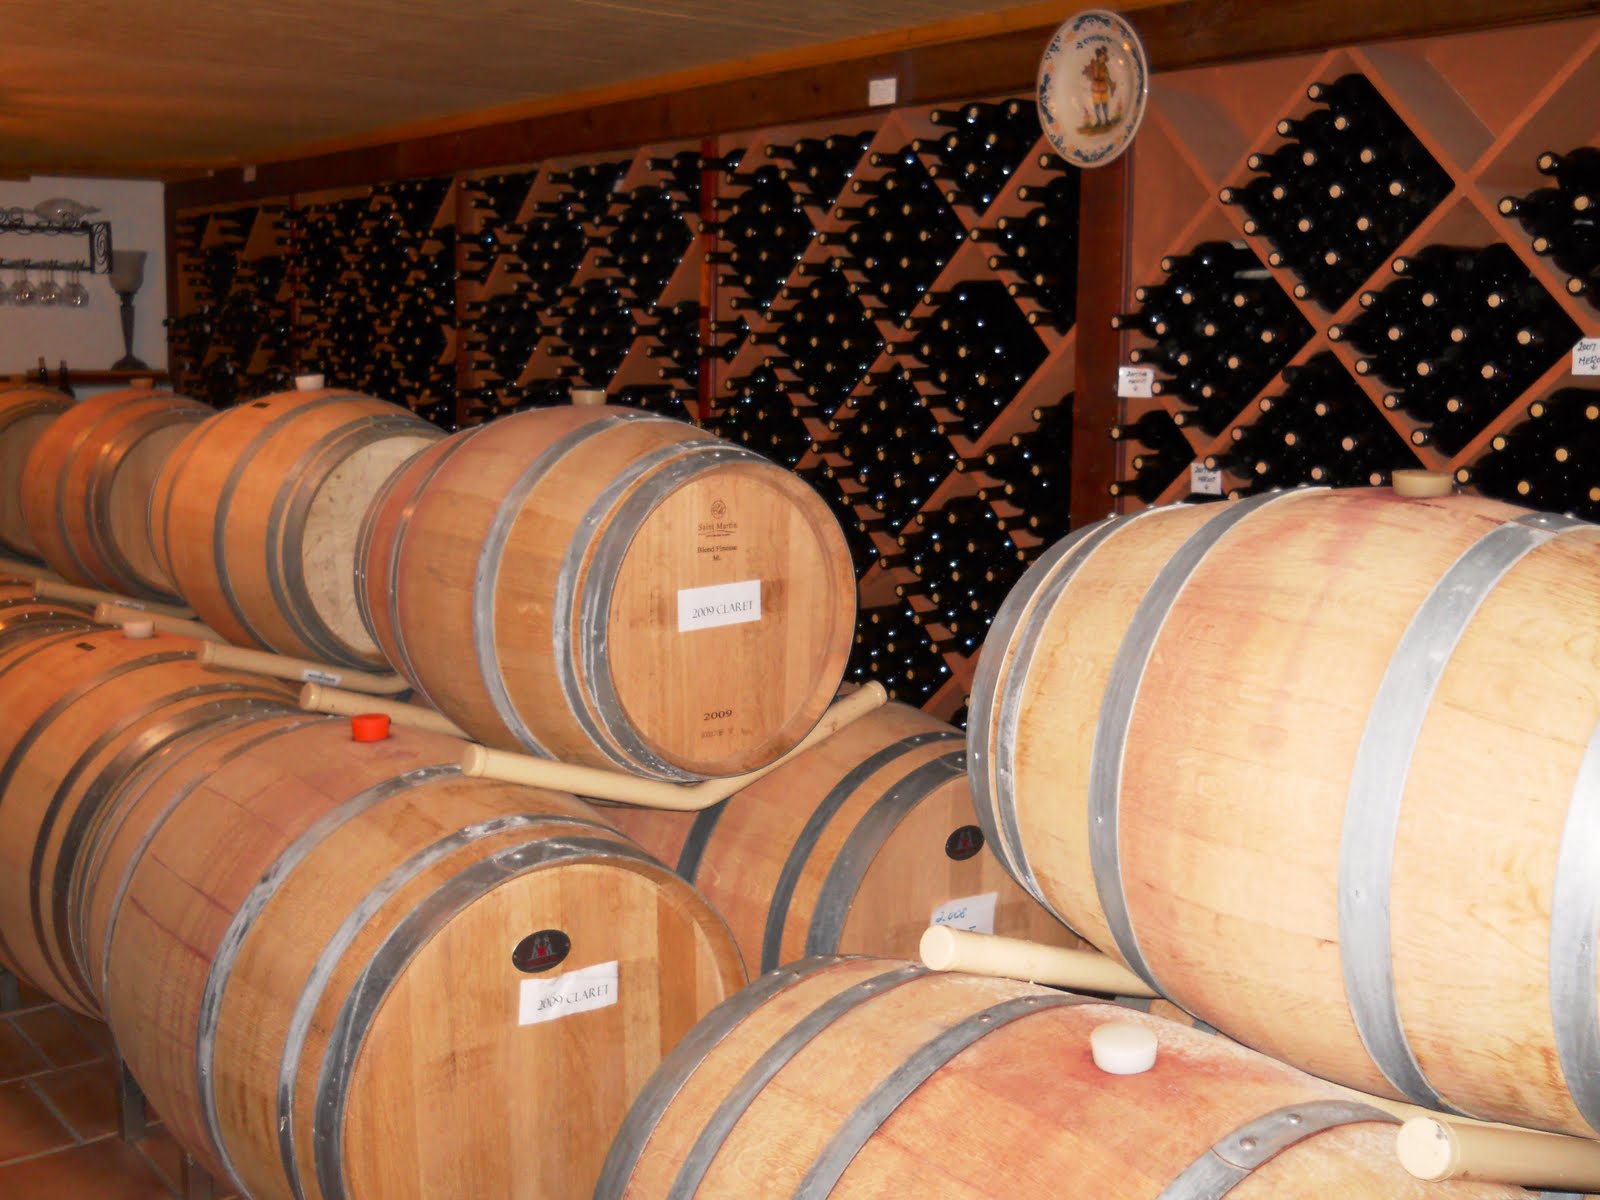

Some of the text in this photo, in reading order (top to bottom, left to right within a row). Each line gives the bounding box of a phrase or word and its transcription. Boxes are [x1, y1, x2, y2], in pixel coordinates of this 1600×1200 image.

[692, 600, 753, 619] 2009 CLARET
[703, 709, 733, 721] 2009
[566, 984, 608, 1004] CLARET
